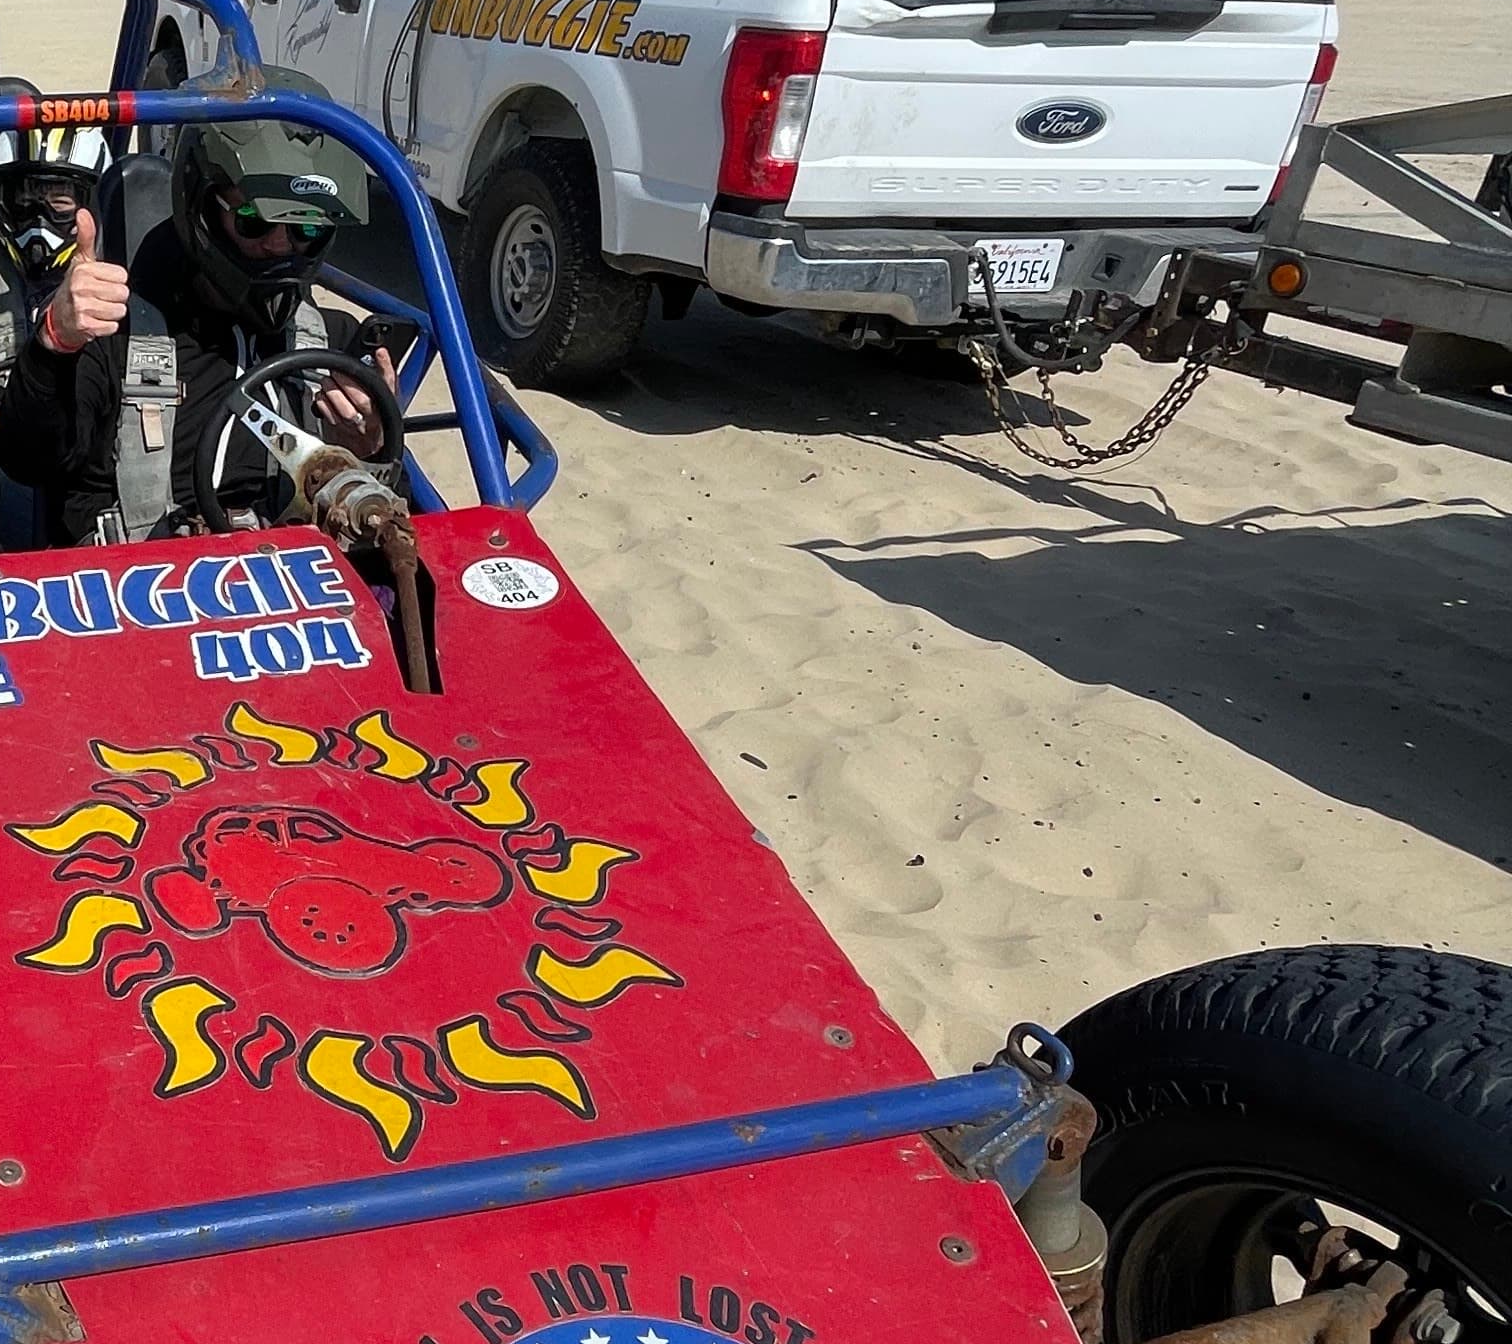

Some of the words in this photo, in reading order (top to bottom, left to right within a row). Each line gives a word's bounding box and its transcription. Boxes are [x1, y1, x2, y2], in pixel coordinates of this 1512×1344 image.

[40, 98, 110, 124] SB404
[1038, 109, 1090, 134] Ford
[870, 176, 1061, 194] SUPER
[1074, 177, 1211, 194] DUTY
[480, 561, 513, 575] SB
[501, 589, 540, 604] 404
[191, 617, 372, 681] 404
[530, 1263, 634, 1320] NOT
